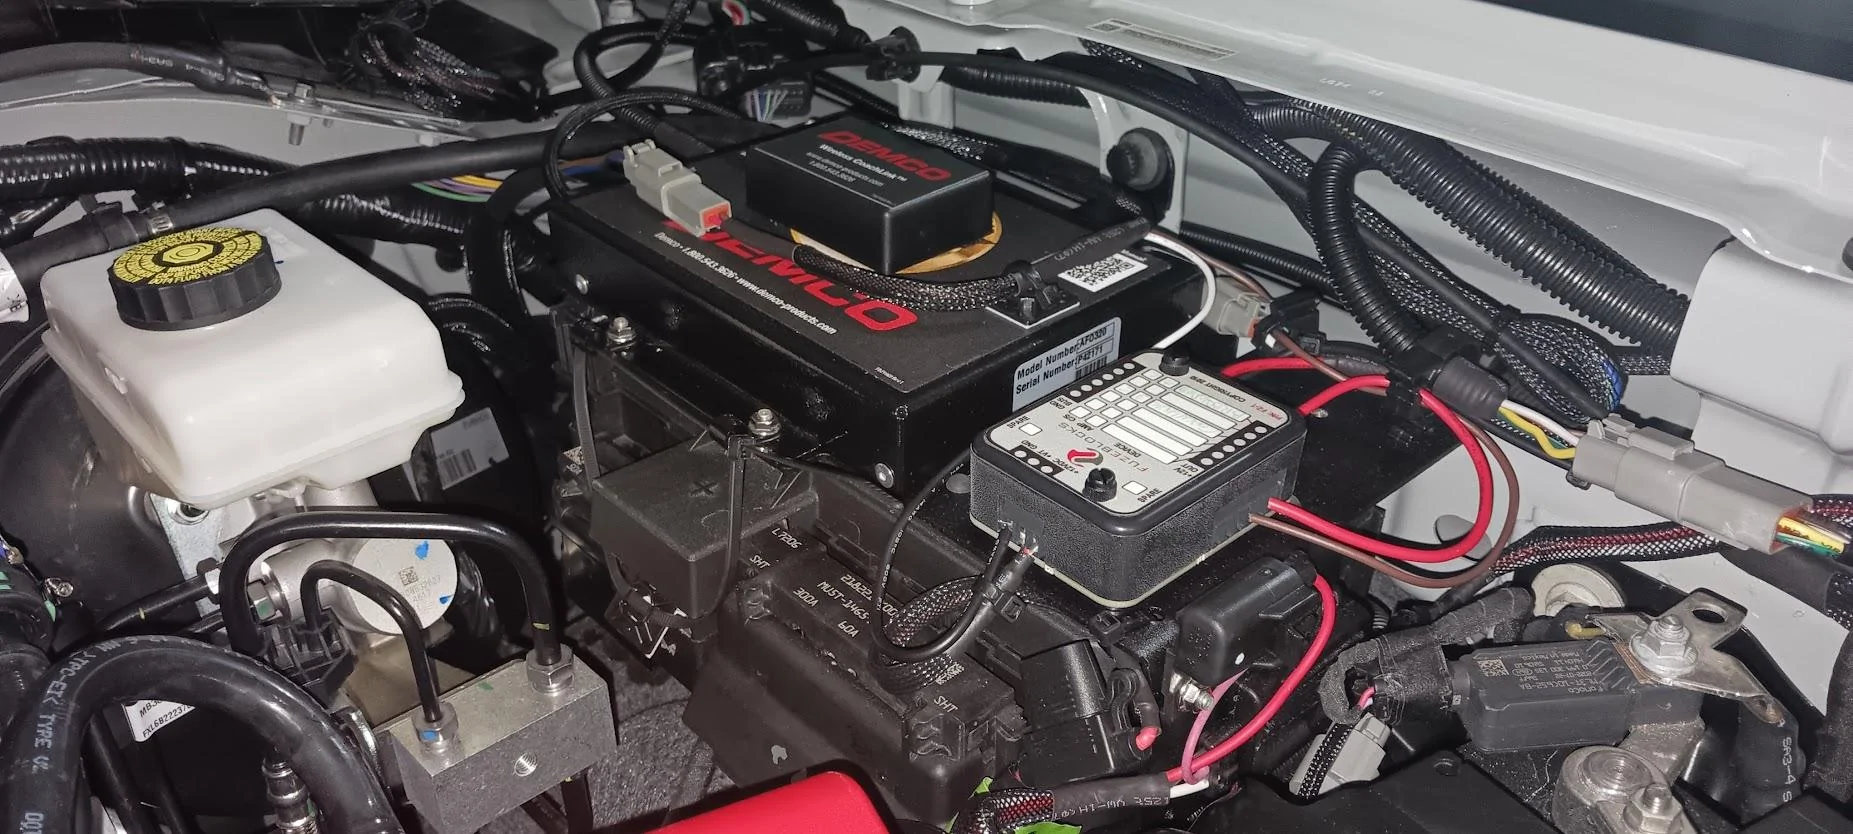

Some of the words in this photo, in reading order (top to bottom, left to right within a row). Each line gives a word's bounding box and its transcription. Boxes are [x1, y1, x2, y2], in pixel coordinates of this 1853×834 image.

[818, 131, 951, 181] DEMCO
[819, 143, 853, 163] Wireless
[653, 231, 680, 249] Demco
[736, 276, 839, 337] www.demco-products.com
[1017, 359, 1043, 380] Model
[1016, 375, 1040, 395] Serial
[1204, 381, 1246, 403] COPYRIGHT
[1049, 400, 1066, 410] GND
[1056, 396, 1074, 407] BUS
[1006, 415, 1030, 429] SPARE
[1076, 423, 1095, 431] AMP
[1020, 439, 1038, 450] GND
[1058, 421, 1150, 472] FUZEBLOCKS
[1113, 442, 1142, 458] DEVICE
[1052, 457, 1079, 474] +12VDC
[1181, 462, 1199, 473] OUT
[1136, 487, 1164, 503] SPARE
[771, 526, 802, 550] L7206
[749, 554, 771, 570] SHT
[792, 586, 819, 608] 300A
[837, 620, 860, 638] 60A
[933, 695, 959, 713] SHT
